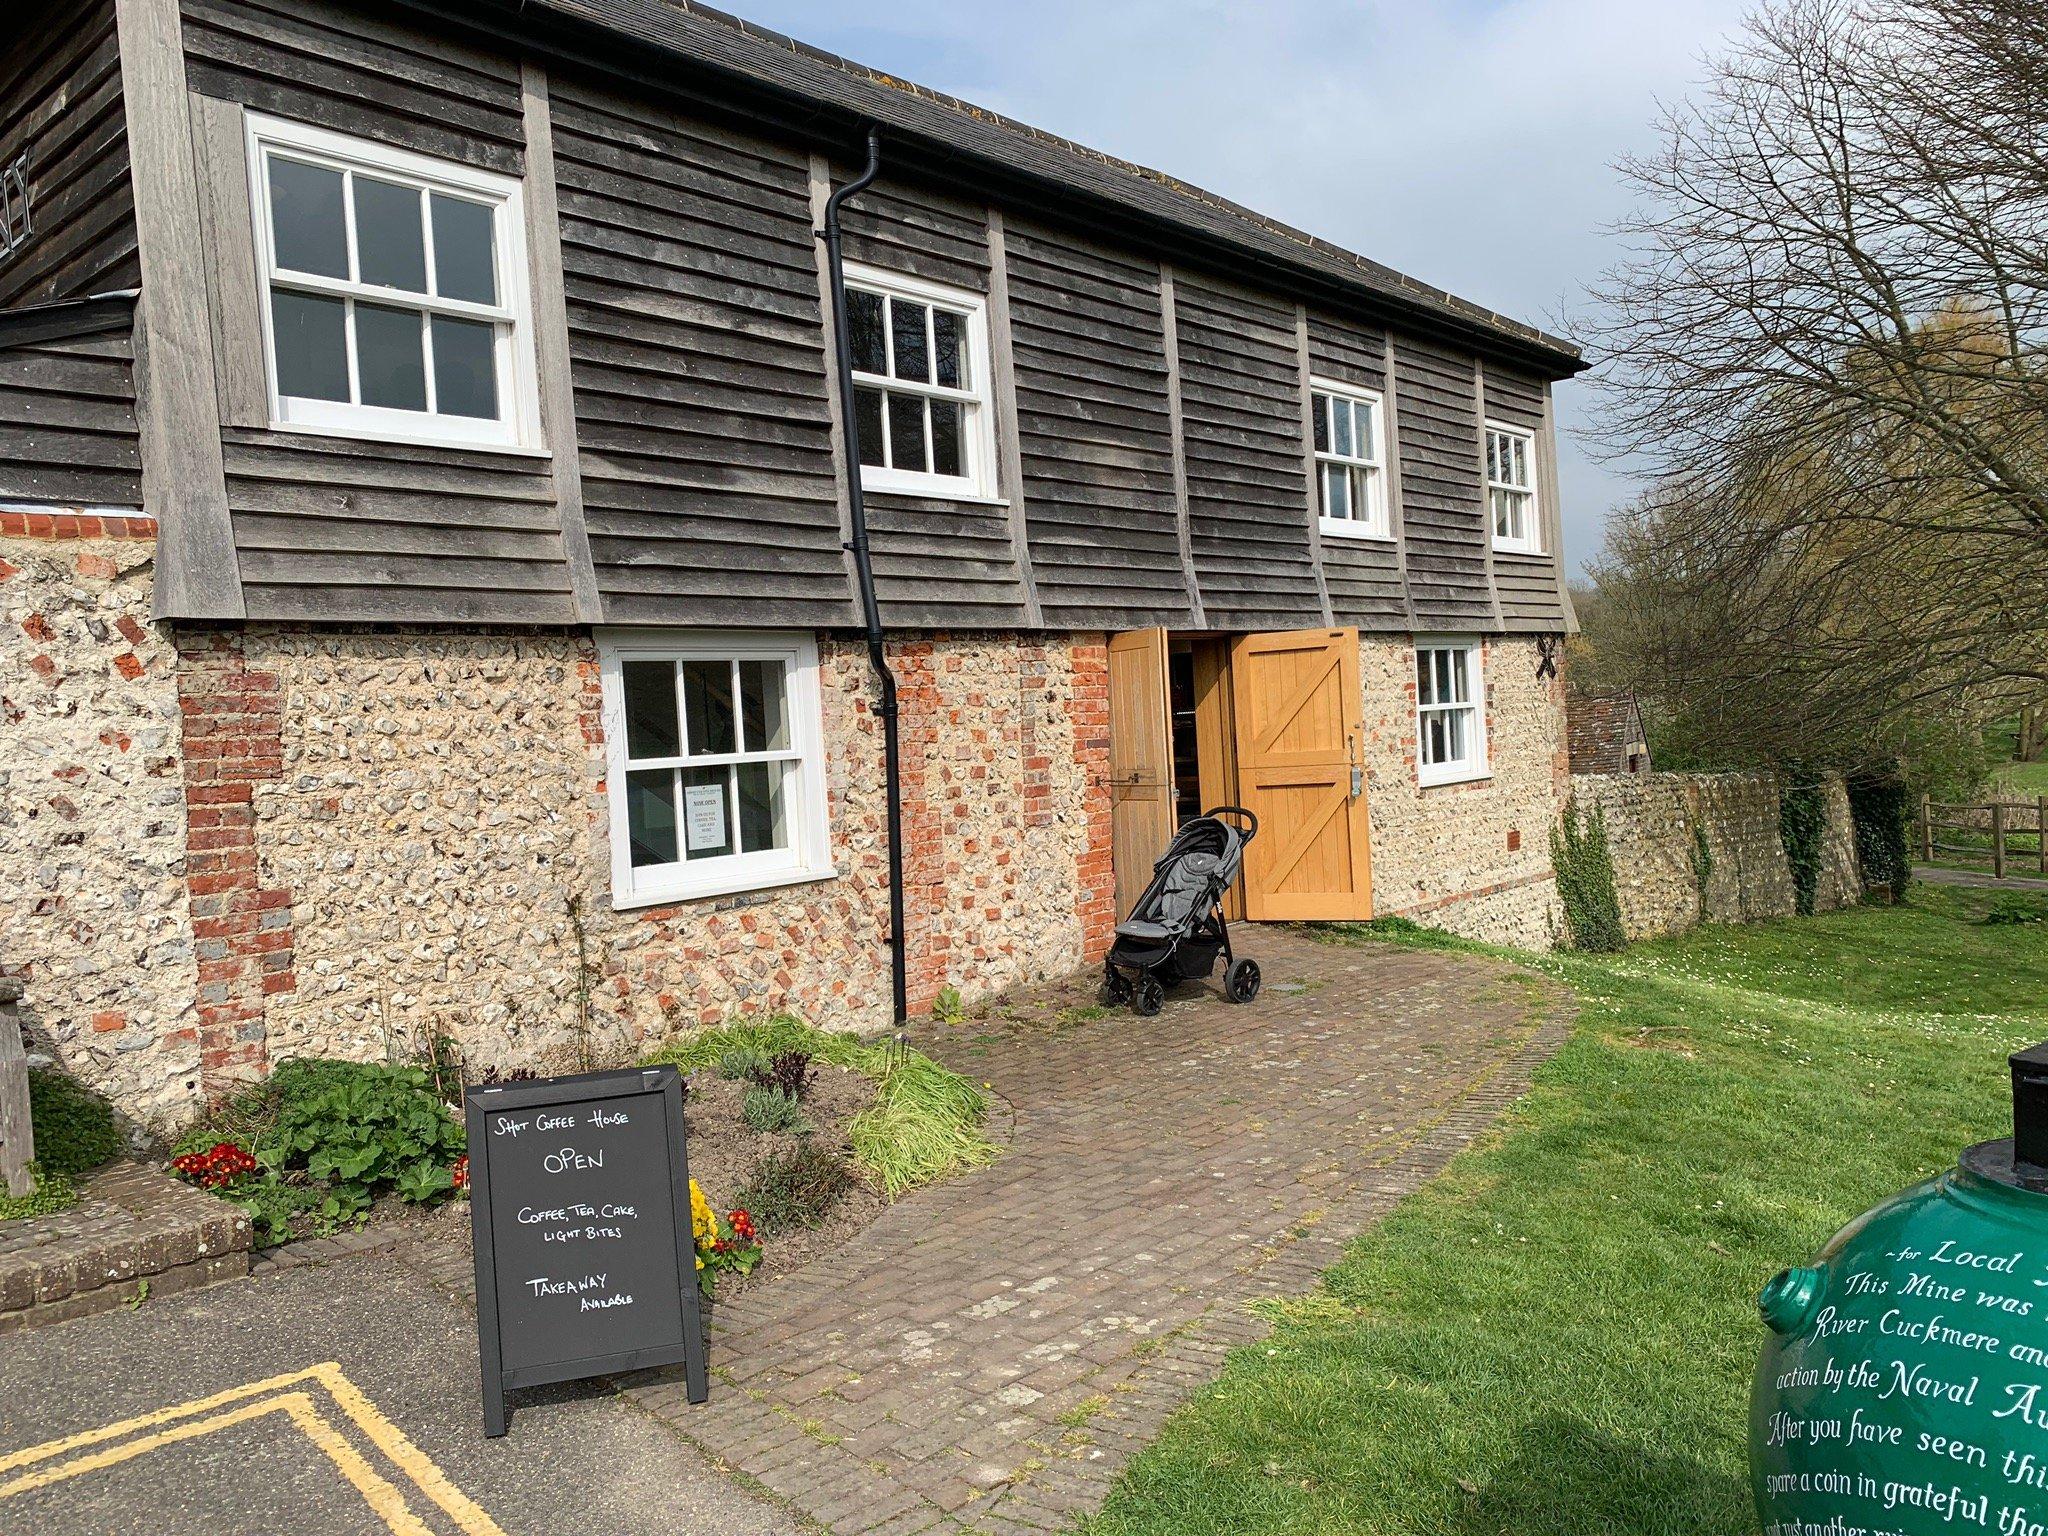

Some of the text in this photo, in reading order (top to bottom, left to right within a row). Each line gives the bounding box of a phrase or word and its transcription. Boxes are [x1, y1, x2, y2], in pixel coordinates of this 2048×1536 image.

[536, 1114, 575, 1131] COFFEE
[587, 1109, 629, 1129] HOUSE
[544, 1147, 603, 1173] OPEN
[517, 1203, 638, 1224] COFFEE, TEA, CAKE,
[544, 1226, 622, 1243] LIGHT BITES
[1928, 1240, 2024, 1274] Local
[525, 1273, 607, 1297] TAKEAWAY
[1844, 1271, 2034, 1316] This Mine was
[580, 1293, 634, 1313] AVAILABLE
[1807, 1305, 1869, 1348] River
[1880, 1308, 2000, 1353] Cuckmere
[1776, 1366, 1819, 1390] action
[1822, 1357, 1844, 1394] by
[1847, 1359, 1880, 1388] the
[1878, 1360, 1979, 1406] Naval
[1766, 1408, 2048, 1491] After you have seen thi
[1766, 1468, 2048, 1536] spare a coin in grateful tha
